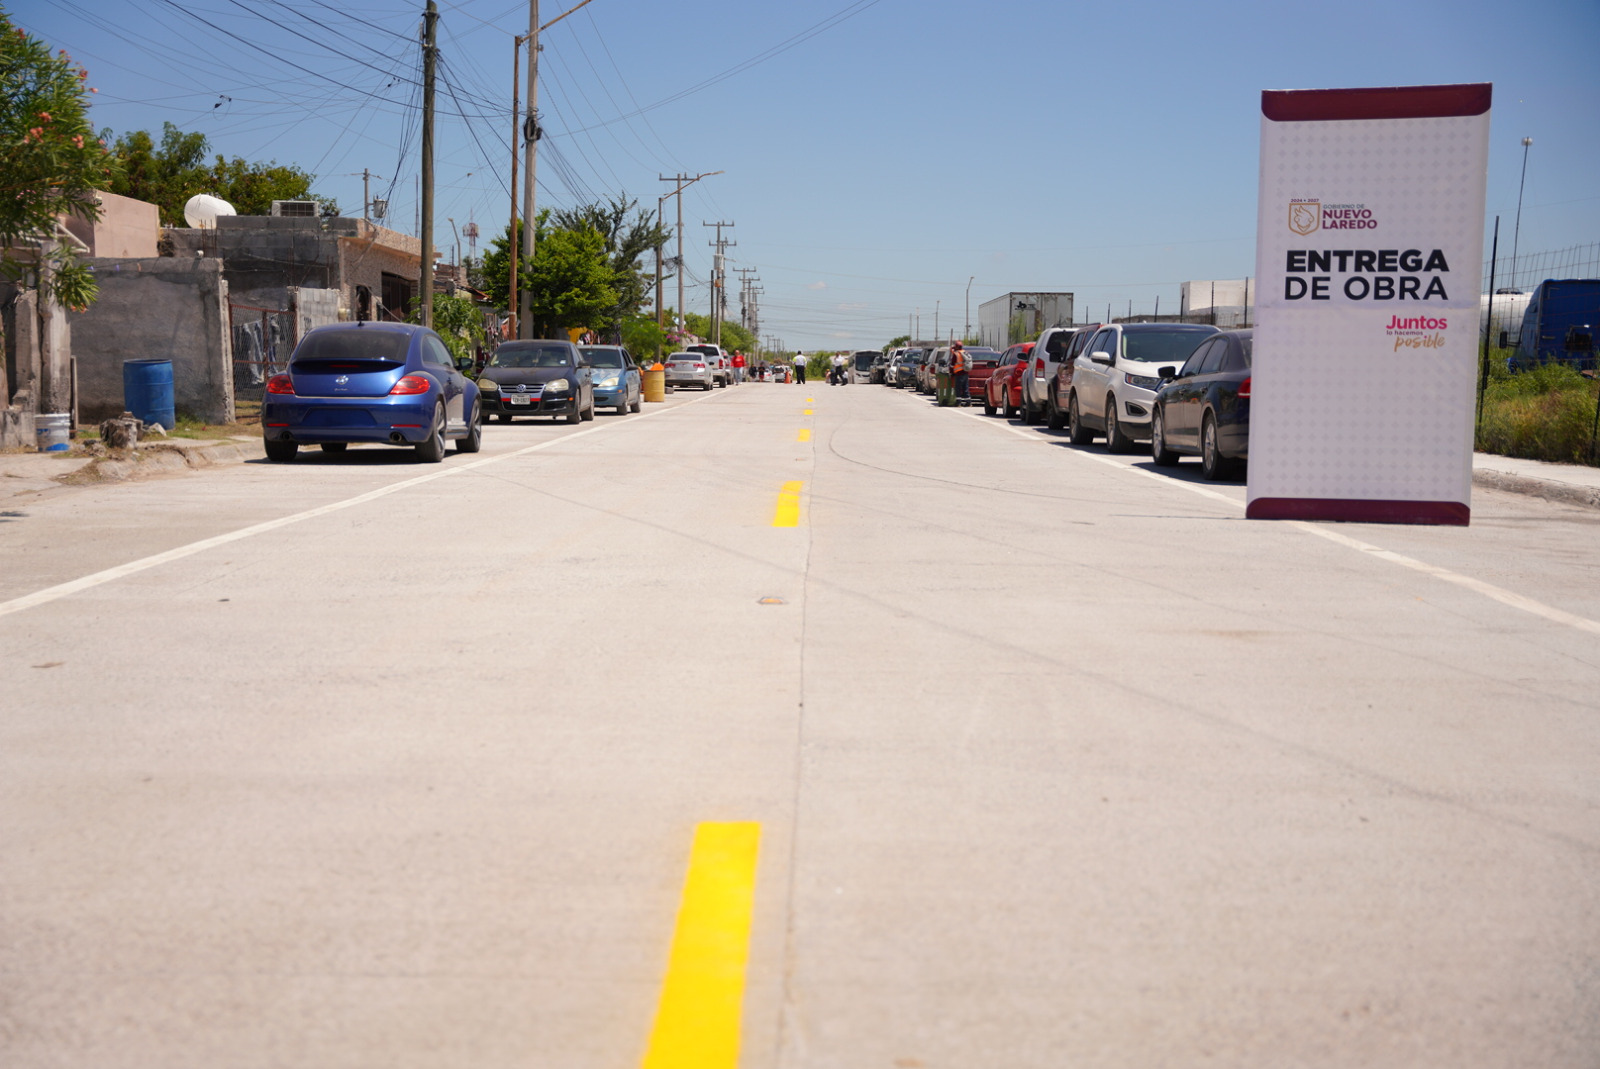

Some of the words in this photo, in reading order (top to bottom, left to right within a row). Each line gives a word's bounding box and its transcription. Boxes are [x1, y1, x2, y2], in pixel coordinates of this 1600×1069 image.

[1322, 209, 1372, 219] NUEVO
[1322, 219, 1378, 230] LAREDO
[1286, 249, 1450, 272] ENTREGA
[1285, 276, 1331, 300] DE
[1343, 276, 1449, 300] OBRA
[1386, 315, 1448, 330] Juntos
[1394, 332, 1446, 352] posible
